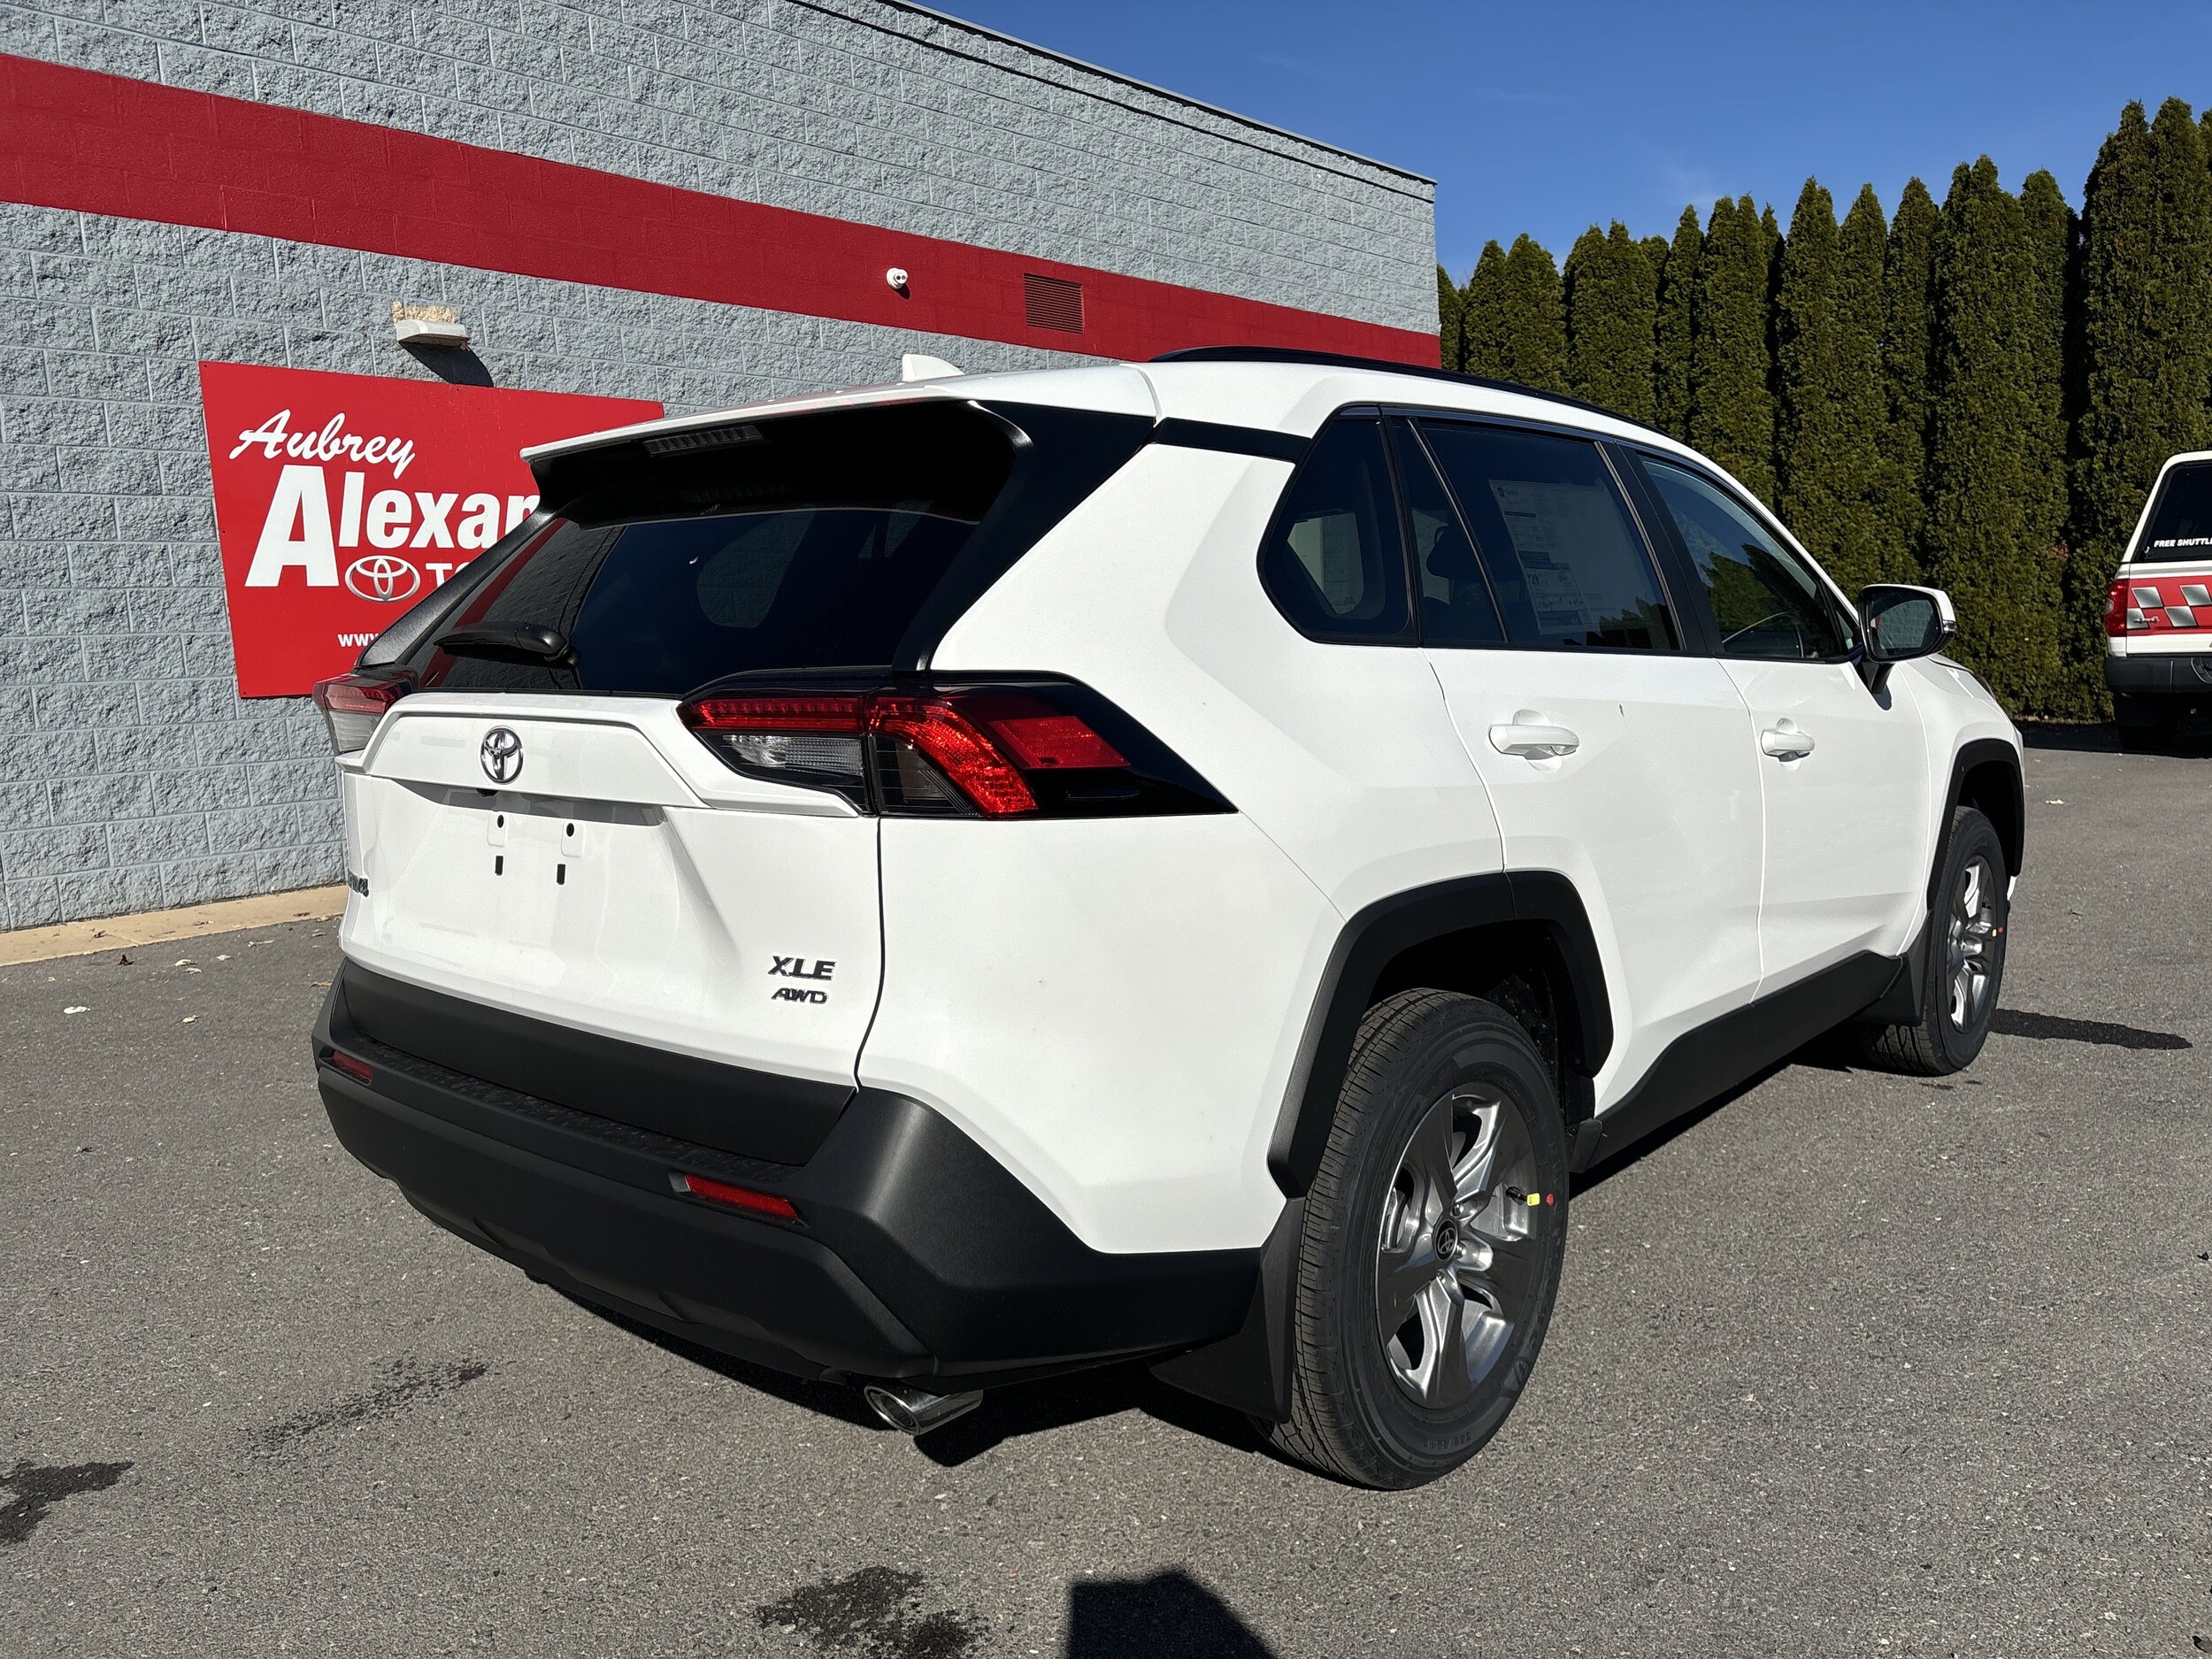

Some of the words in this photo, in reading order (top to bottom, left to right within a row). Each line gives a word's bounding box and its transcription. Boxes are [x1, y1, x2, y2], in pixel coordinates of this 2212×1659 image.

[228, 408, 416, 480] Aubrey
[2154, 539, 2177, 548] FREE
[425, 561, 471, 588] T
[767, 955, 837, 981] XLE
[771, 987, 828, 1004] AWD
